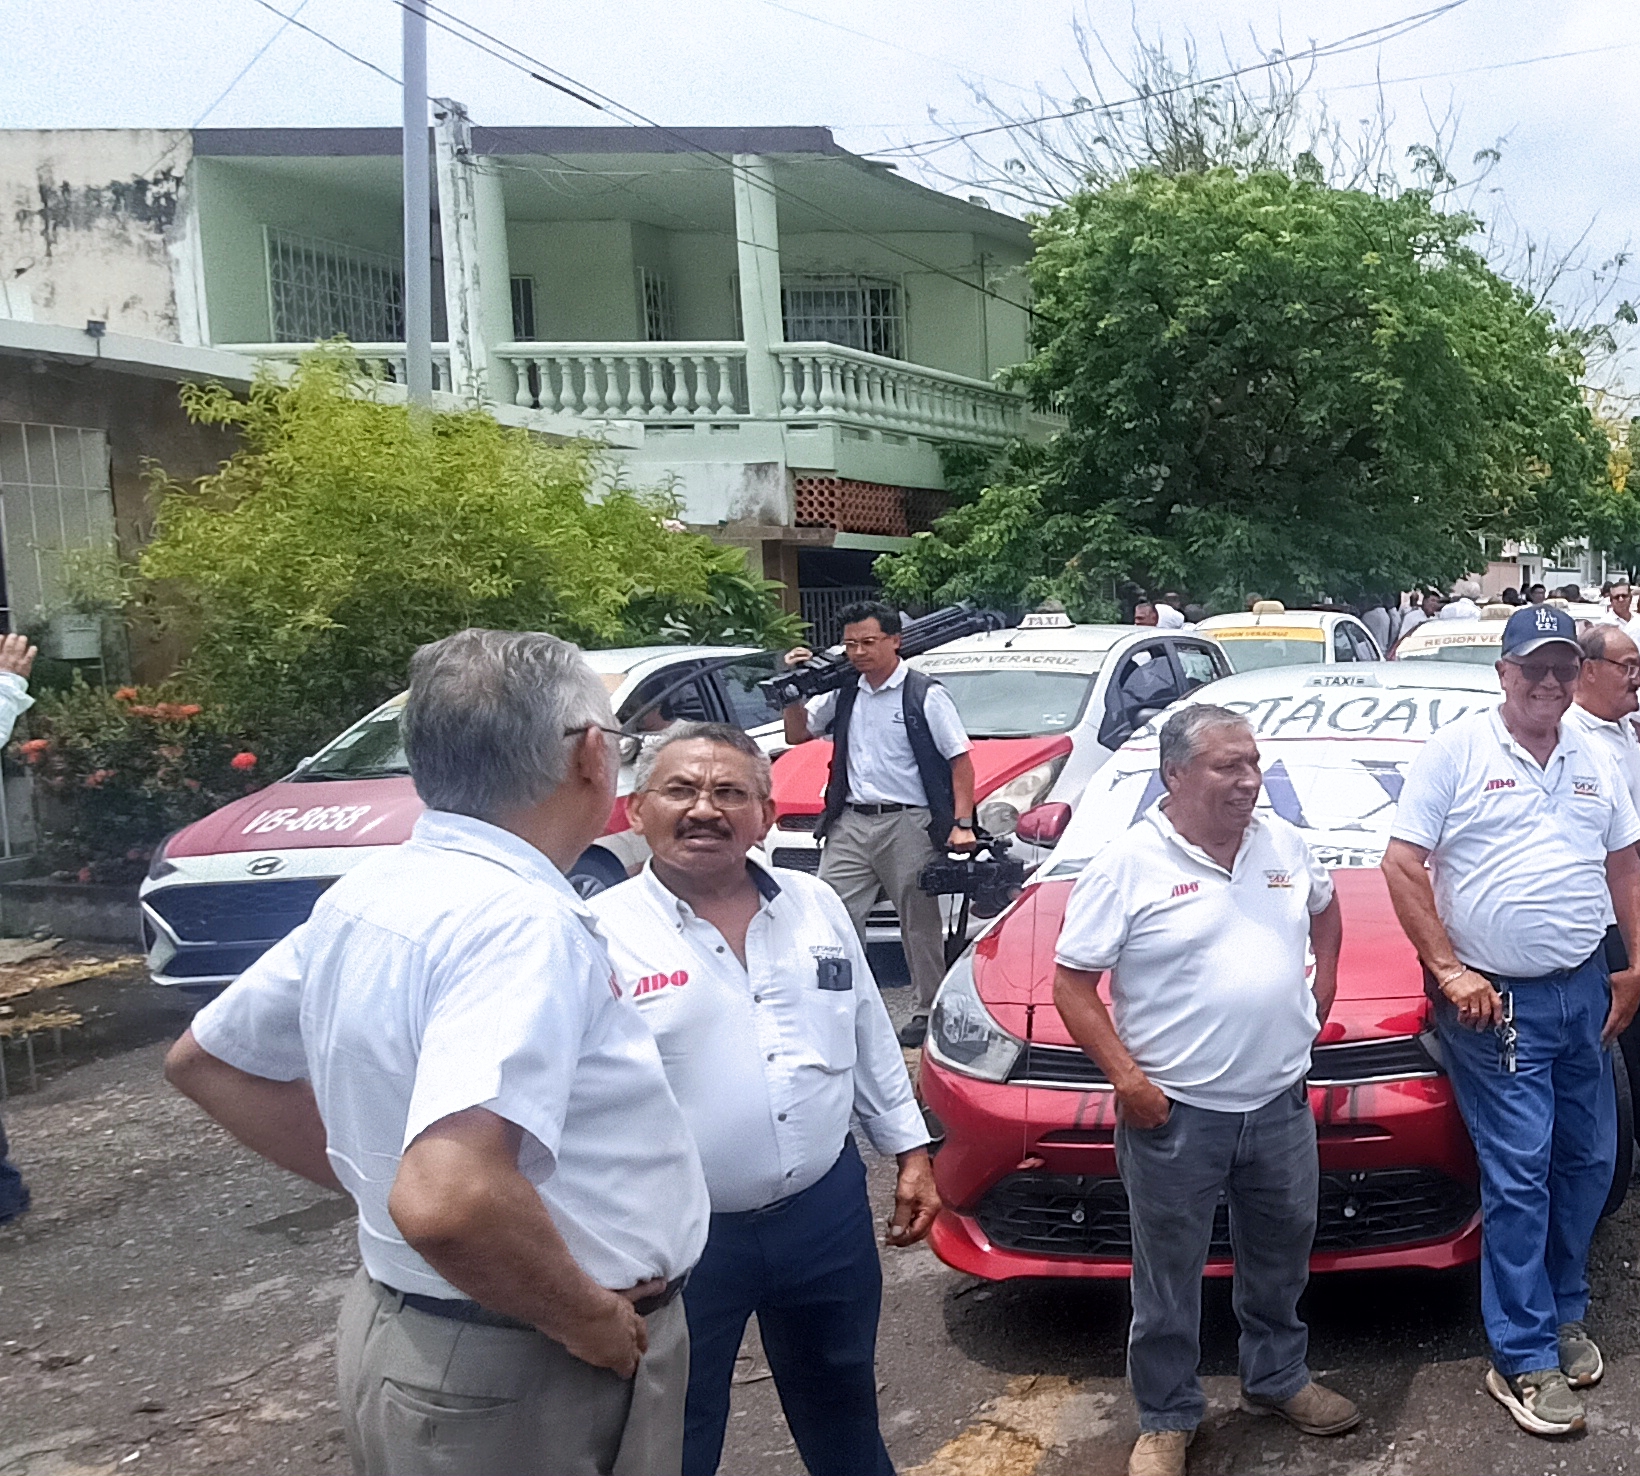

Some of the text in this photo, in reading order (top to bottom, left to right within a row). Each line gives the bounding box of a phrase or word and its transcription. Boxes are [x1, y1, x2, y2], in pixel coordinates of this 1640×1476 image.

[1027, 616, 1060, 626] TAXI
[1480, 634, 1502, 643] VE
[989, 655, 1080, 667] VERACRUZ
[1484, 779, 1516, 792] ADO
[1572, 781, 1599, 792] TAXI
[240, 805, 371, 834] VB-8658
[1171, 881, 1200, 898] ADO
[633, 970, 689, 997] ADO
